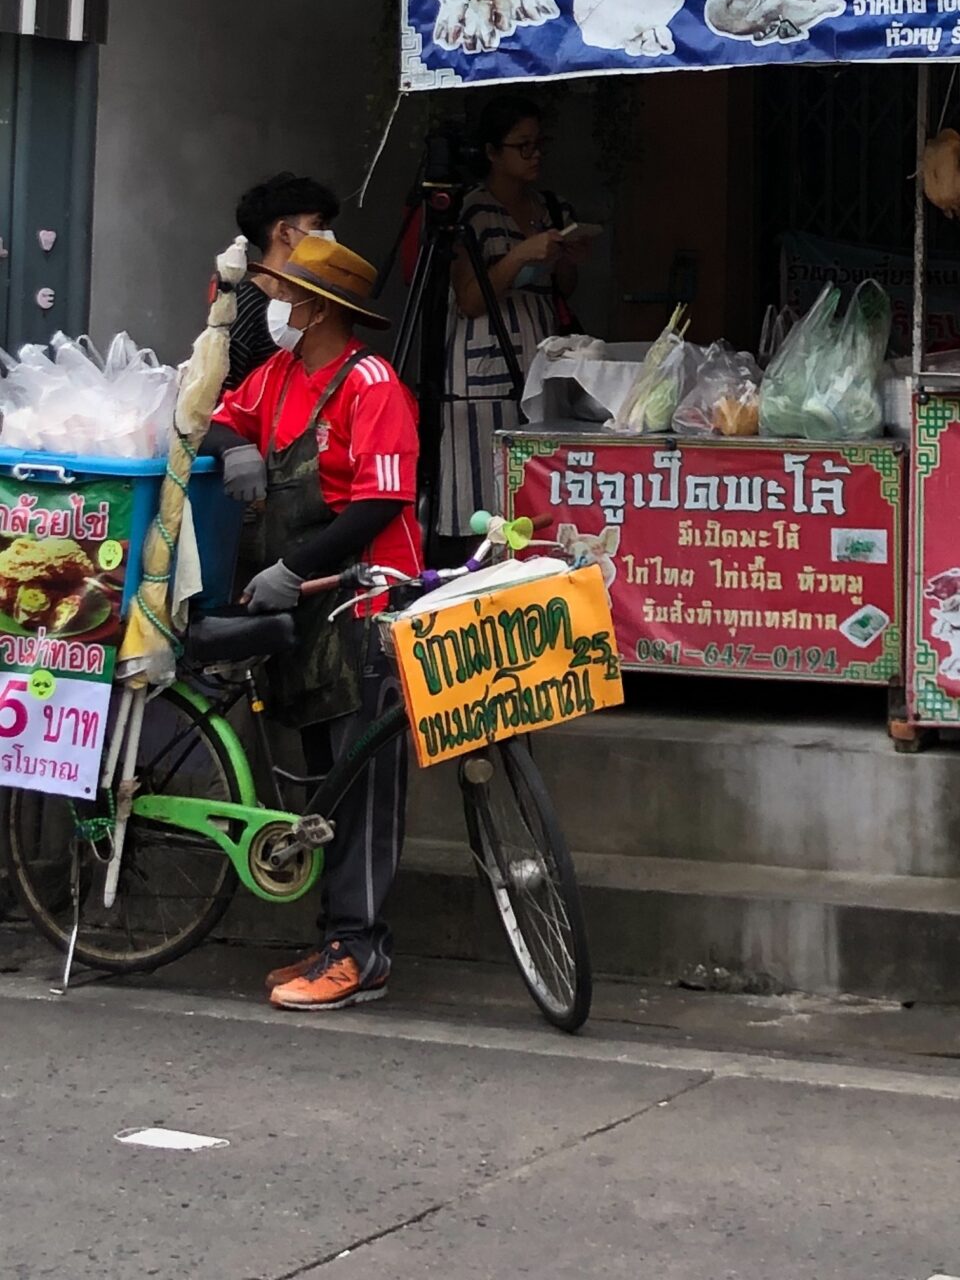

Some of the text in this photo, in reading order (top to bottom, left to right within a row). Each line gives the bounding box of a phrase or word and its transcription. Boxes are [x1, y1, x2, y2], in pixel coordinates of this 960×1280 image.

[885, 21, 942, 52] หัวหมู
[549, 449, 852, 524] เจ๊จูเป็ดพะโล้
[621, 555, 696, 588] ไก่ไทย
[797, 569, 864, 605] หัวหมู
[636, 639, 838, 670] 081-647-0194
[43, 704, 99, 749] บาท
